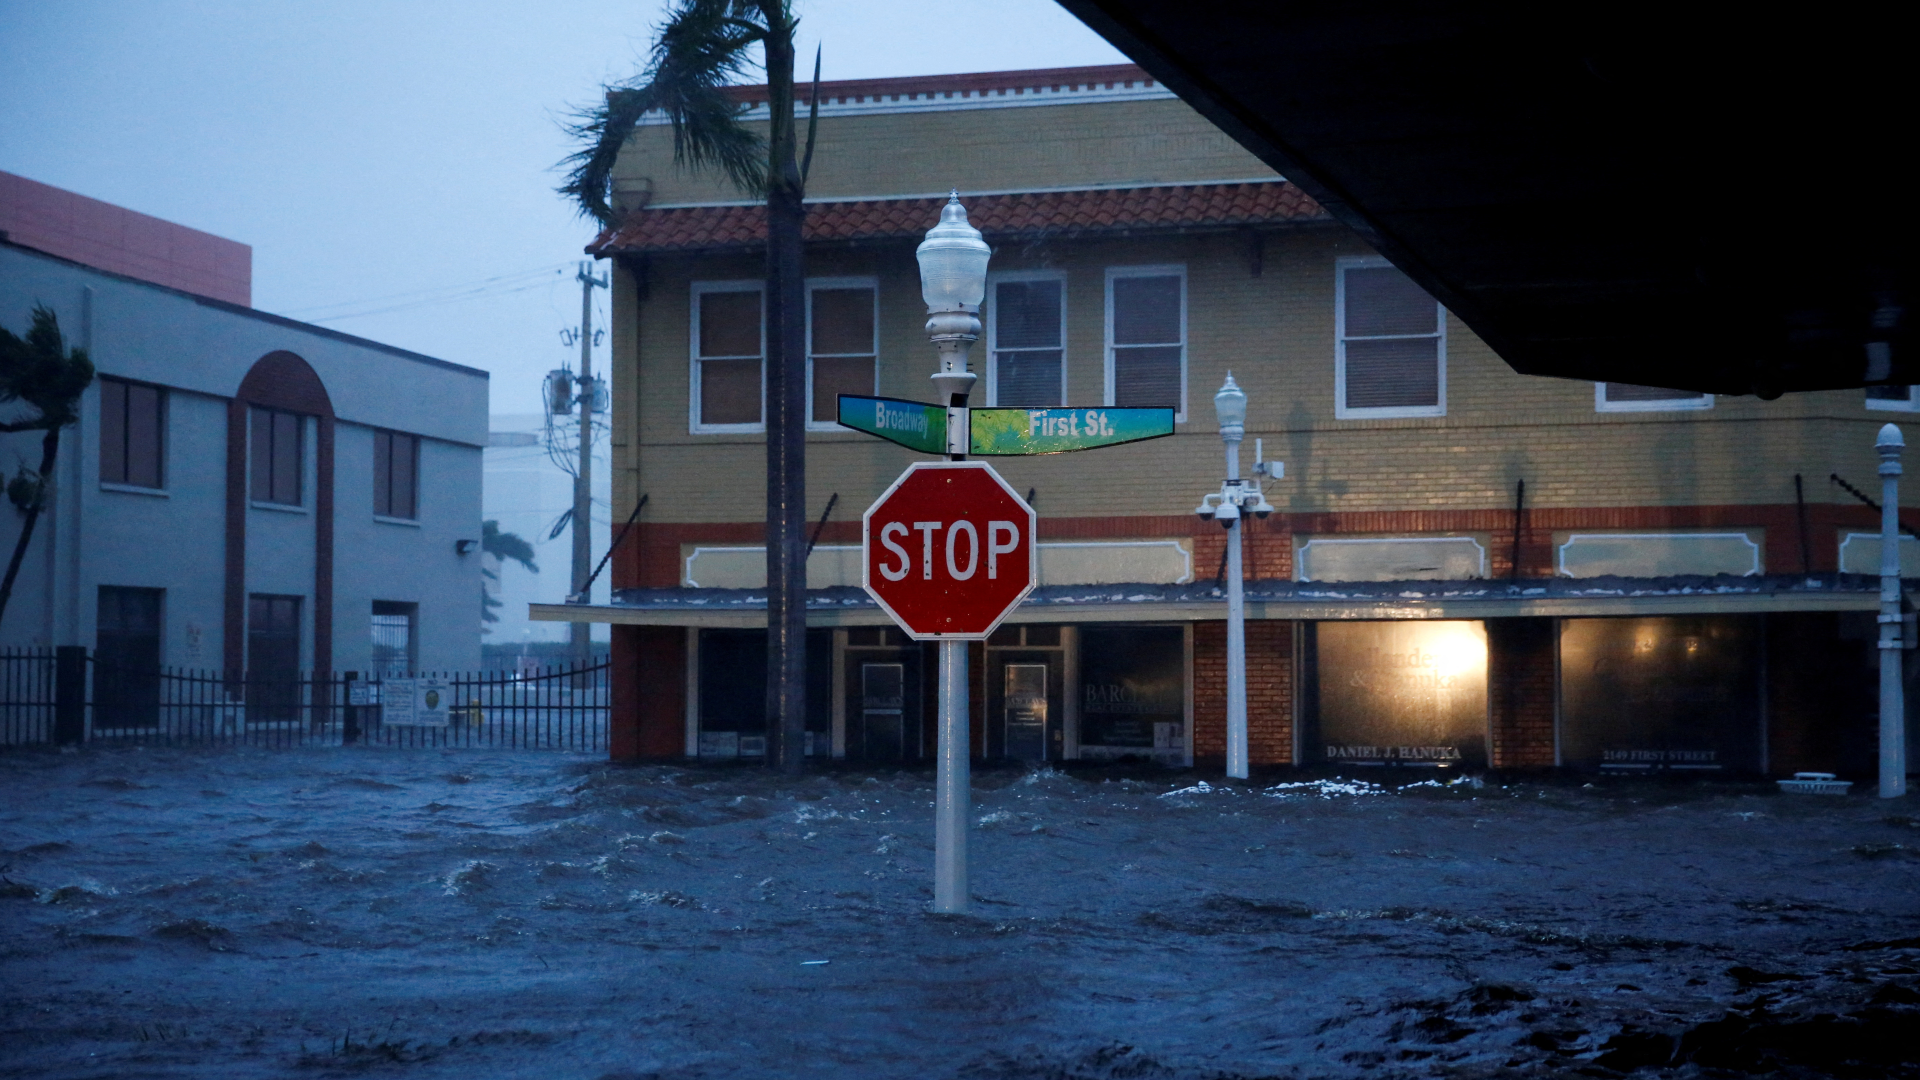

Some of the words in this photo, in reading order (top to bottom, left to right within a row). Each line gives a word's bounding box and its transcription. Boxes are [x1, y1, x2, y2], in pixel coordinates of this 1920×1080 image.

[875, 402, 929, 439] Broadway
[1028, 410, 1078, 437] First
[1085, 410, 1114, 437] St.
[879, 520, 1020, 581] STOP
[1326, 745, 1381, 759] DANIEL
[1384, 745, 1396, 759] J.
[1399, 745, 1462, 760] HANUKA
[1630, 750, 1666, 761] FIRST
[1668, 750, 1717, 761] STREET
